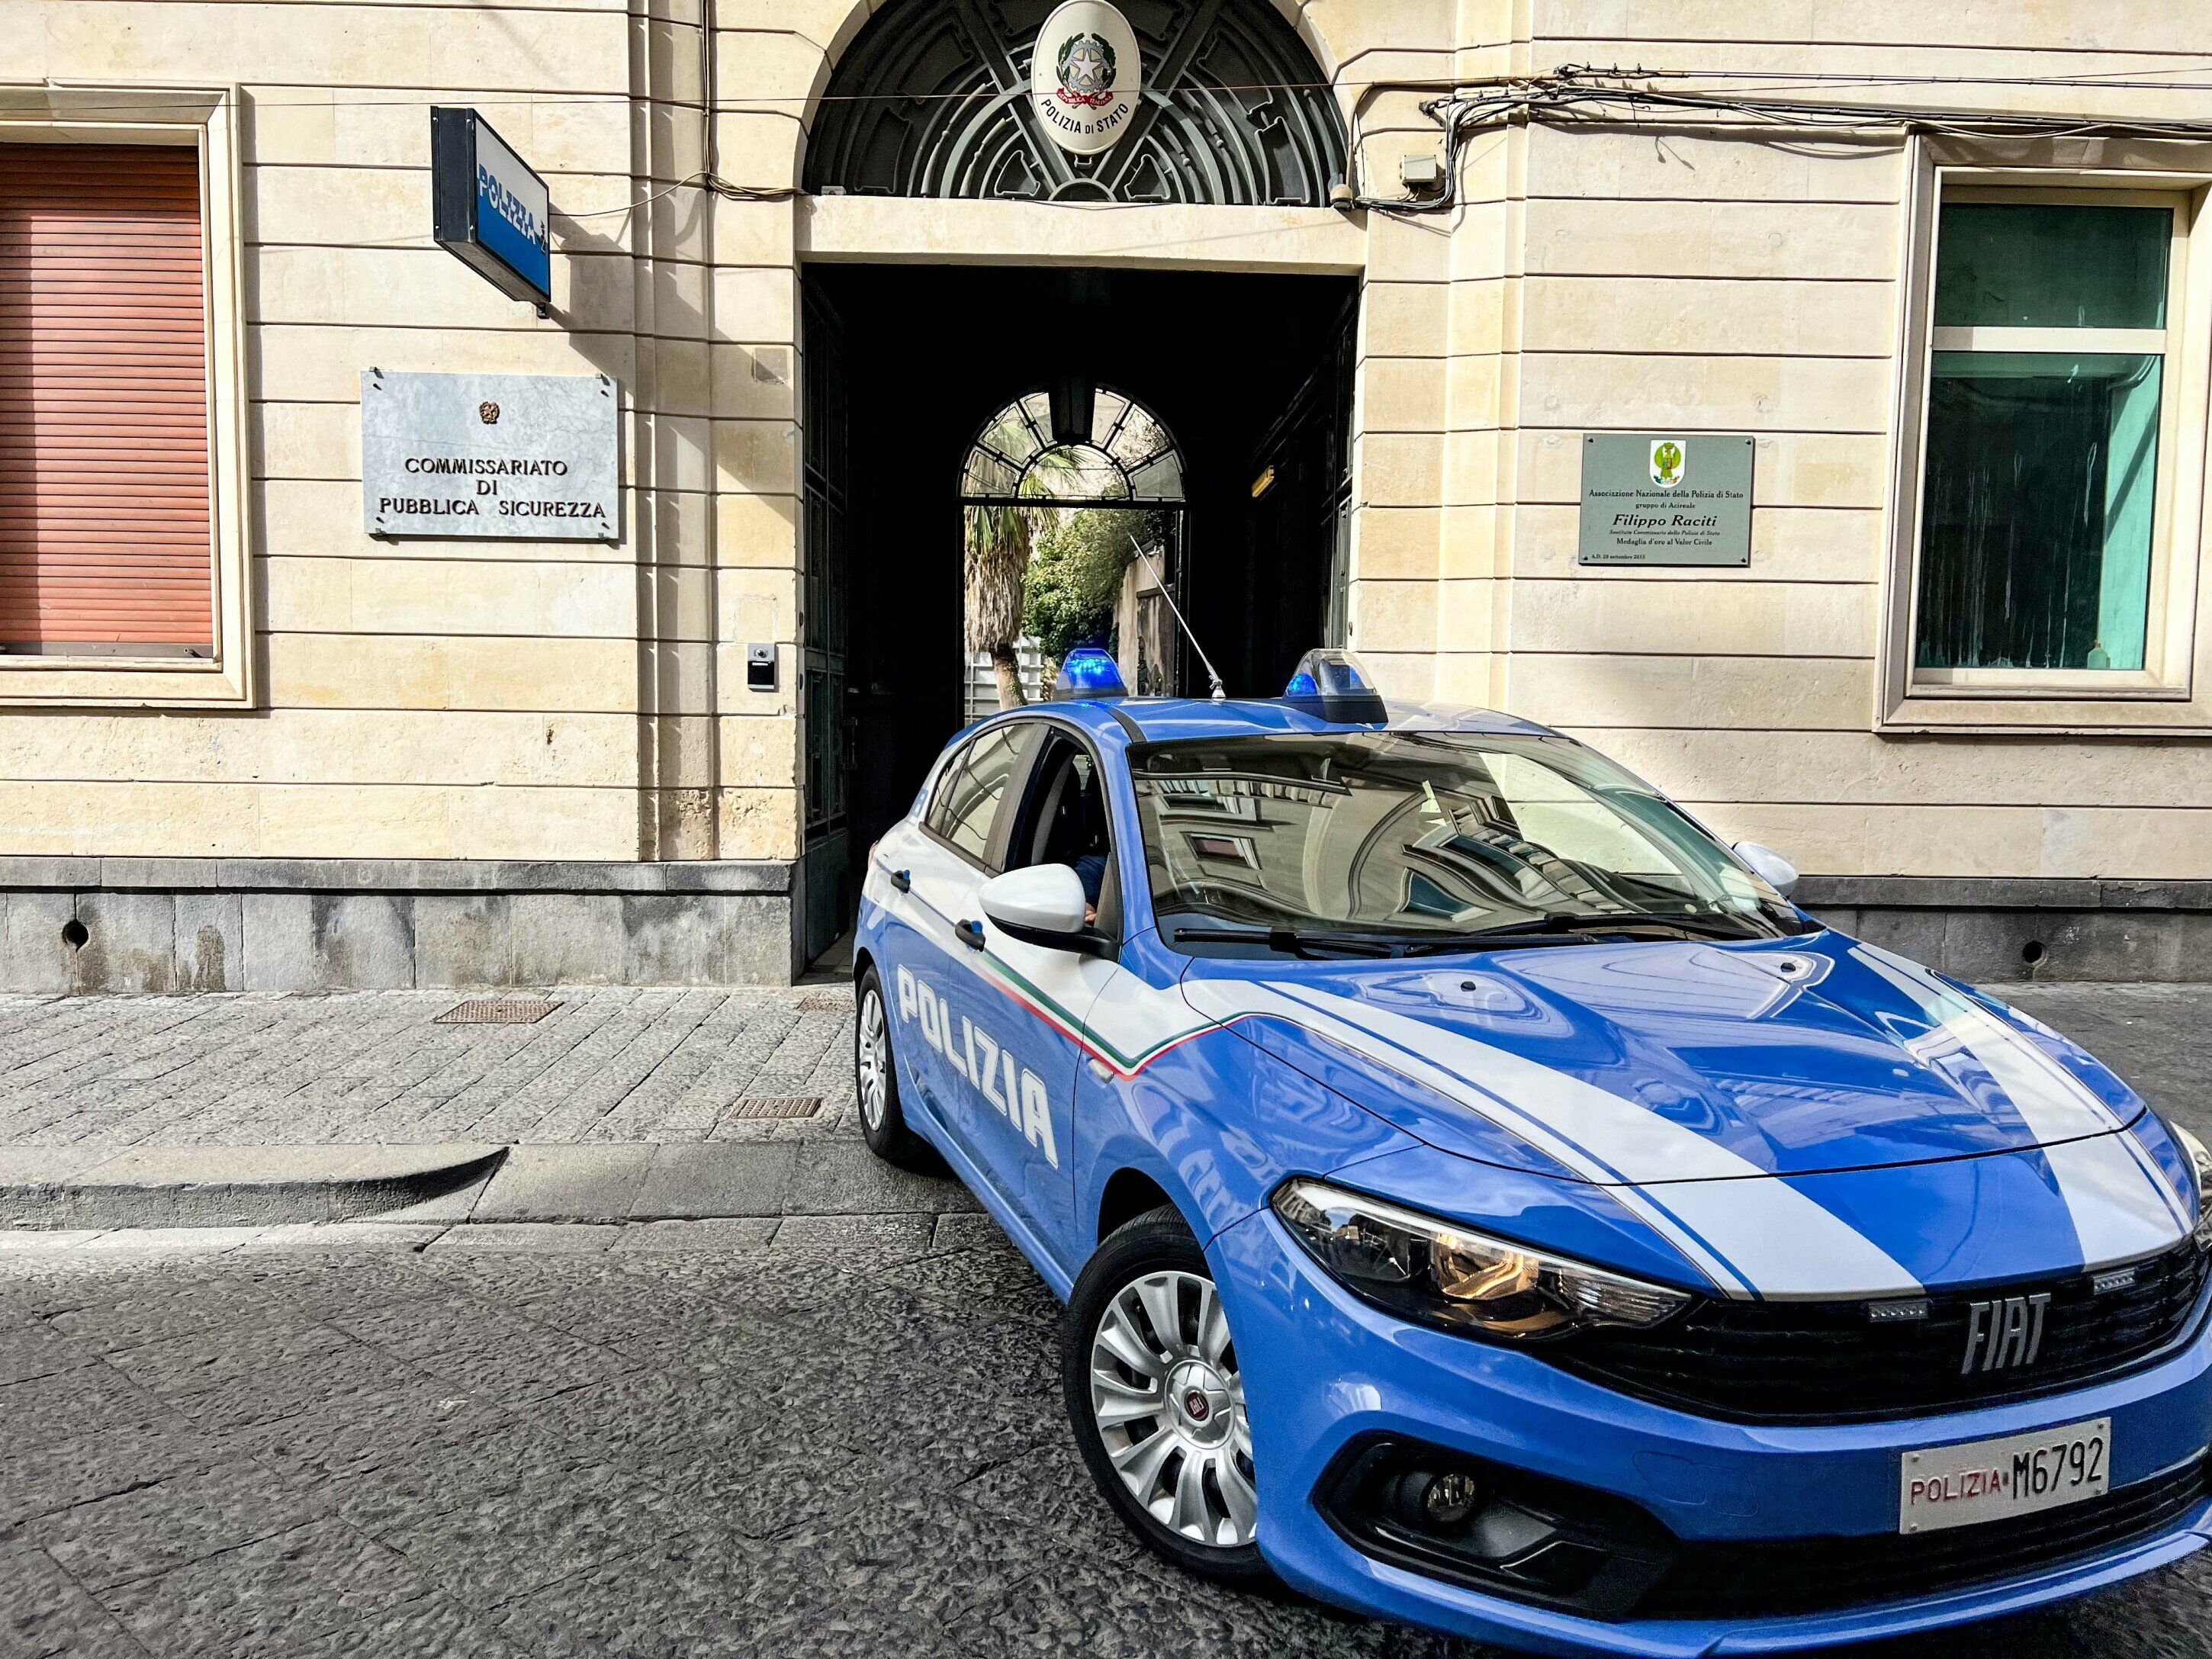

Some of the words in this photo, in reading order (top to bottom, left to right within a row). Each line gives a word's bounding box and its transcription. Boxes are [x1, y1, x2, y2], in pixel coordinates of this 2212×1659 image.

[1041, 99, 1081, 133] POLIZIA
[1085, 125, 1094, 133] DI
[1097, 103, 1128, 133] STATO
[479, 163, 536, 246] POLIZIA
[405, 458, 567, 475] COMMISSARIATO
[476, 480, 497, 495] DI
[1589, 489, 1634, 497] Associazione
[1635, 489, 1670, 497] Nazionale
[1672, 490, 1690, 498] della
[1691, 490, 1715, 498] Polizia
[1716, 490, 1723, 498] di
[380, 497, 479, 515] PUBBLICA
[499, 500, 606, 518] SICUREZZA
[1612, 514, 1667, 529] Filippo
[1670, 514, 1718, 526] Raciti
[898, 963, 1059, 1170] POLIZIA
[1962, 1293, 2051, 1374] FIAT
[1911, 1468, 2002, 1506] POLIZIA
[2012, 1436, 2104, 1500] M6792
